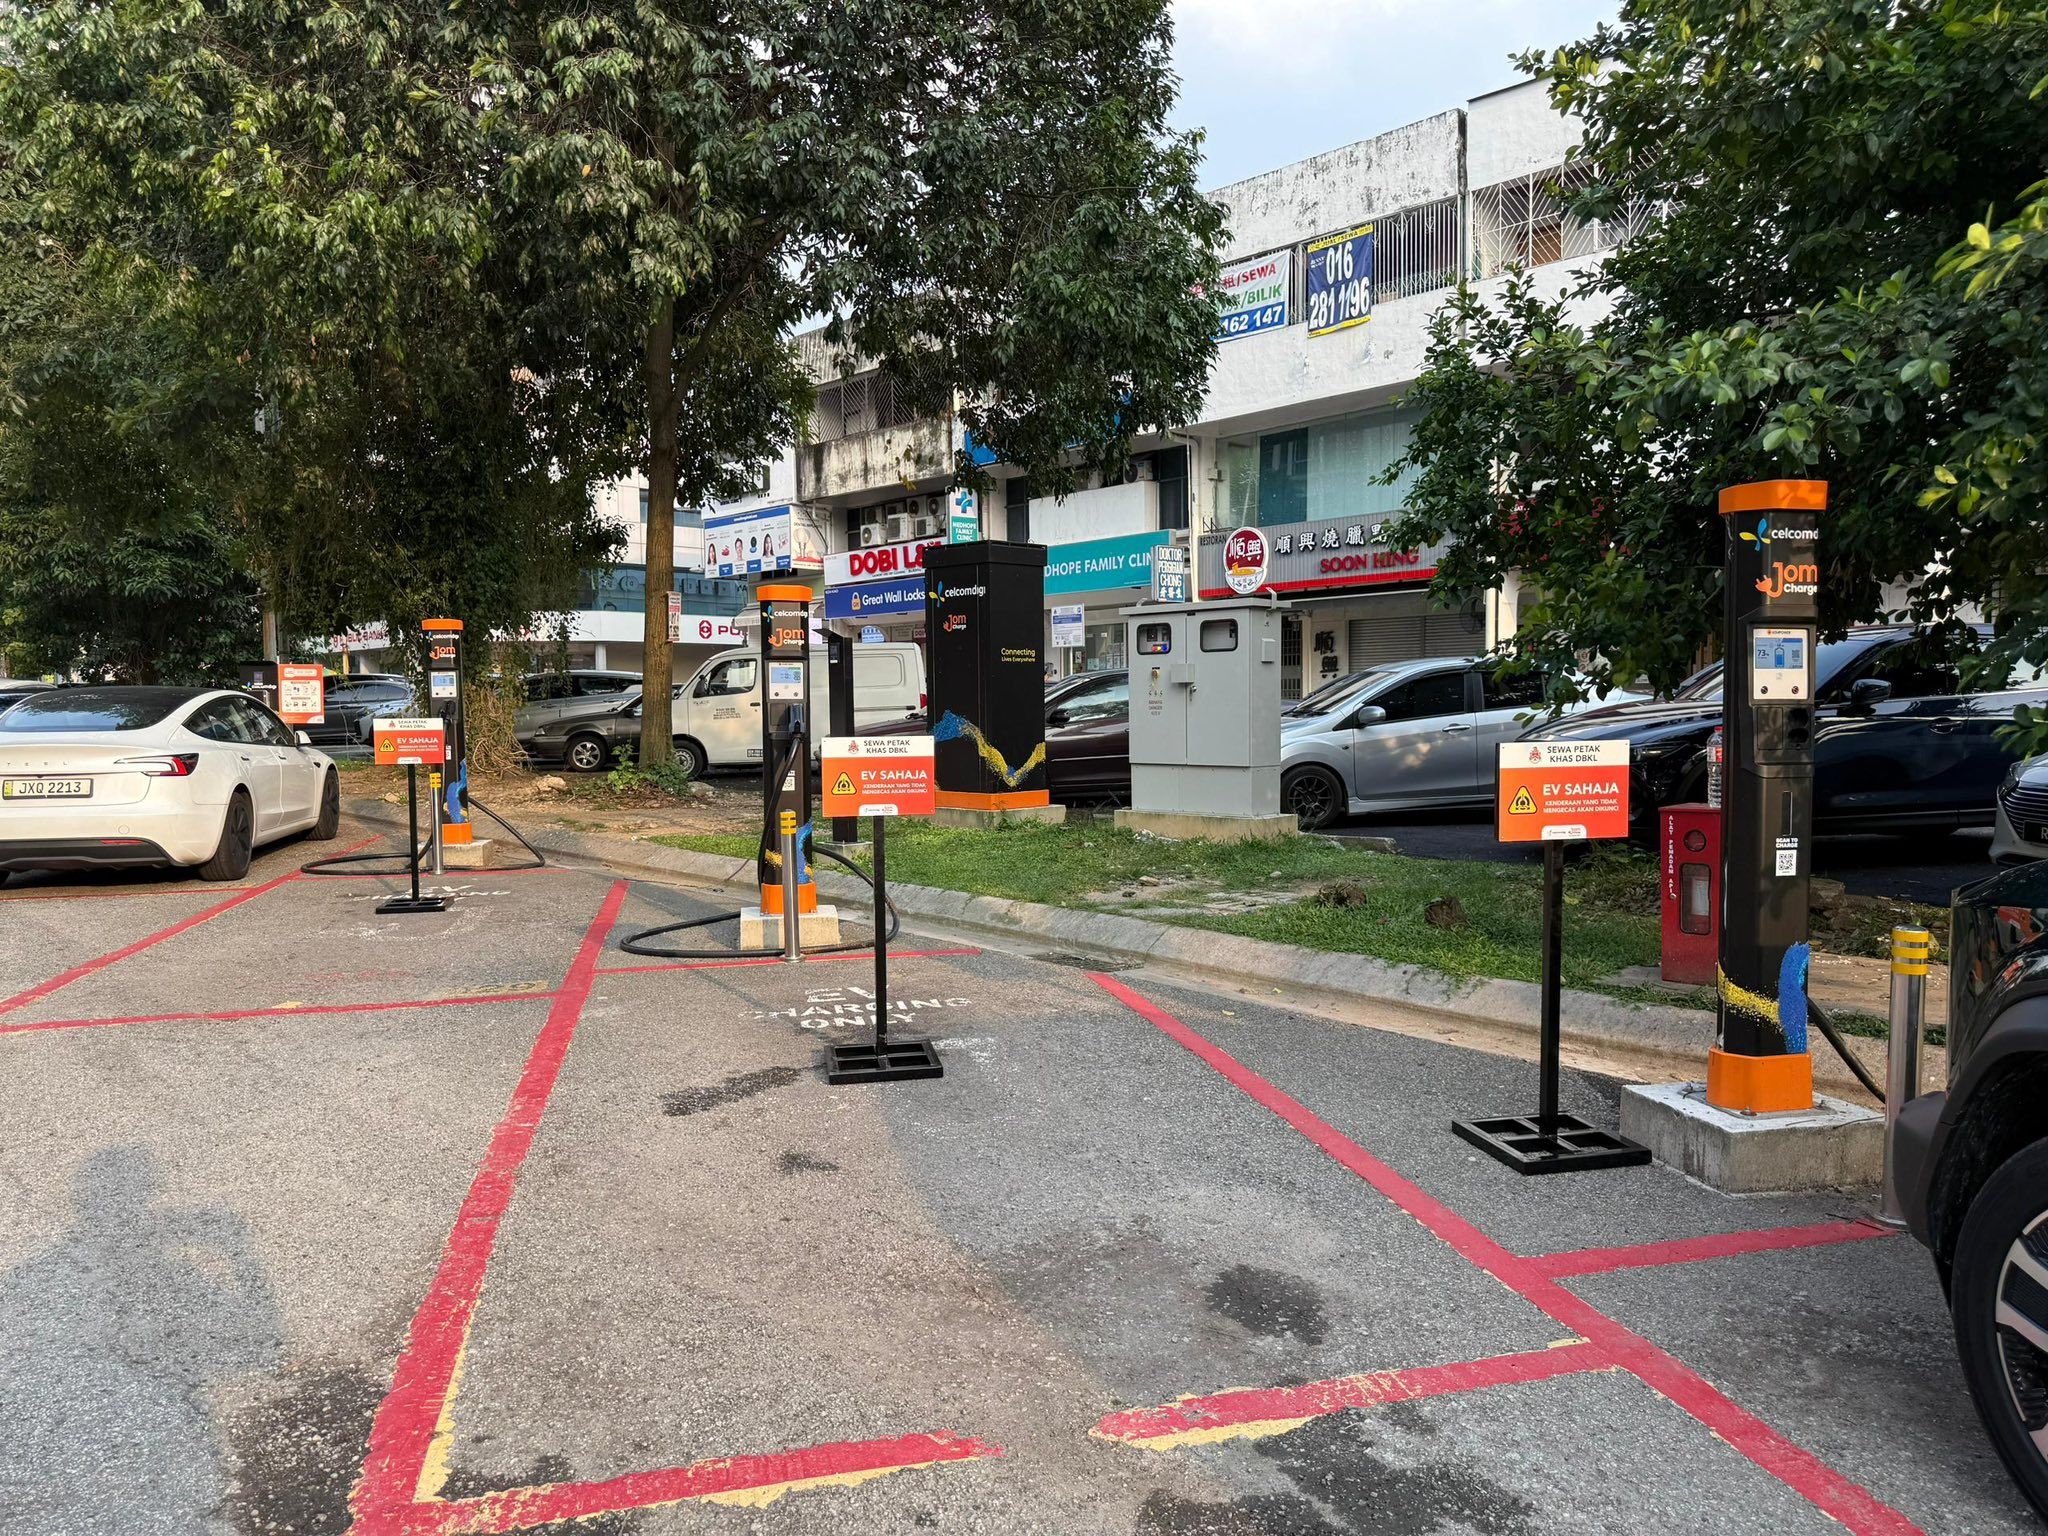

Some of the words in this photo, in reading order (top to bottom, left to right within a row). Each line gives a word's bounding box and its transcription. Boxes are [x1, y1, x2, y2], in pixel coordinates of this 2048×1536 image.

[1326, 241, 1353, 284] 016
[1230, 284, 1282, 308] /BILIK
[1309, 287, 1335, 330] 281
[1338, 277, 1371, 321] 1196
[1253, 305, 1283, 327] 147
[956, 534, 974, 542] CLINIC
[1159, 547, 1183, 561] DOKTOR
[1228, 537, 1262, 561] 順興
[849, 547, 898, 577] DOBI
[1084, 555, 1125, 572] FAMILY
[1319, 553, 1368, 574] SOON
[1160, 573, 1182, 587] CHONG
[1758, 562, 1817, 598] Jom
[862, 593, 883, 606] Great
[884, 590, 902, 603] Wall
[904, 587, 926, 602] Locks
[945, 584, 986, 598] celcomdigi
[944, 614, 967, 632] Jom
[769, 627, 804, 647] Jom
[1000, 647, 1036, 658] Connecting
[1547, 745, 1572, 754] SEWA
[1573, 745, 1600, 753] PETAK
[1549, 755, 1573, 763] KHAS
[1575, 754, 1598, 762] DBKL
[861, 770, 876, 780] EV
[880, 770, 928, 780] SAHAJA
[19, 782, 44, 794] JXQ
[48, 781, 81, 793] 2213
[1543, 784, 1561, 796] EV
[1564, 782, 1619, 795] SAHAJA
